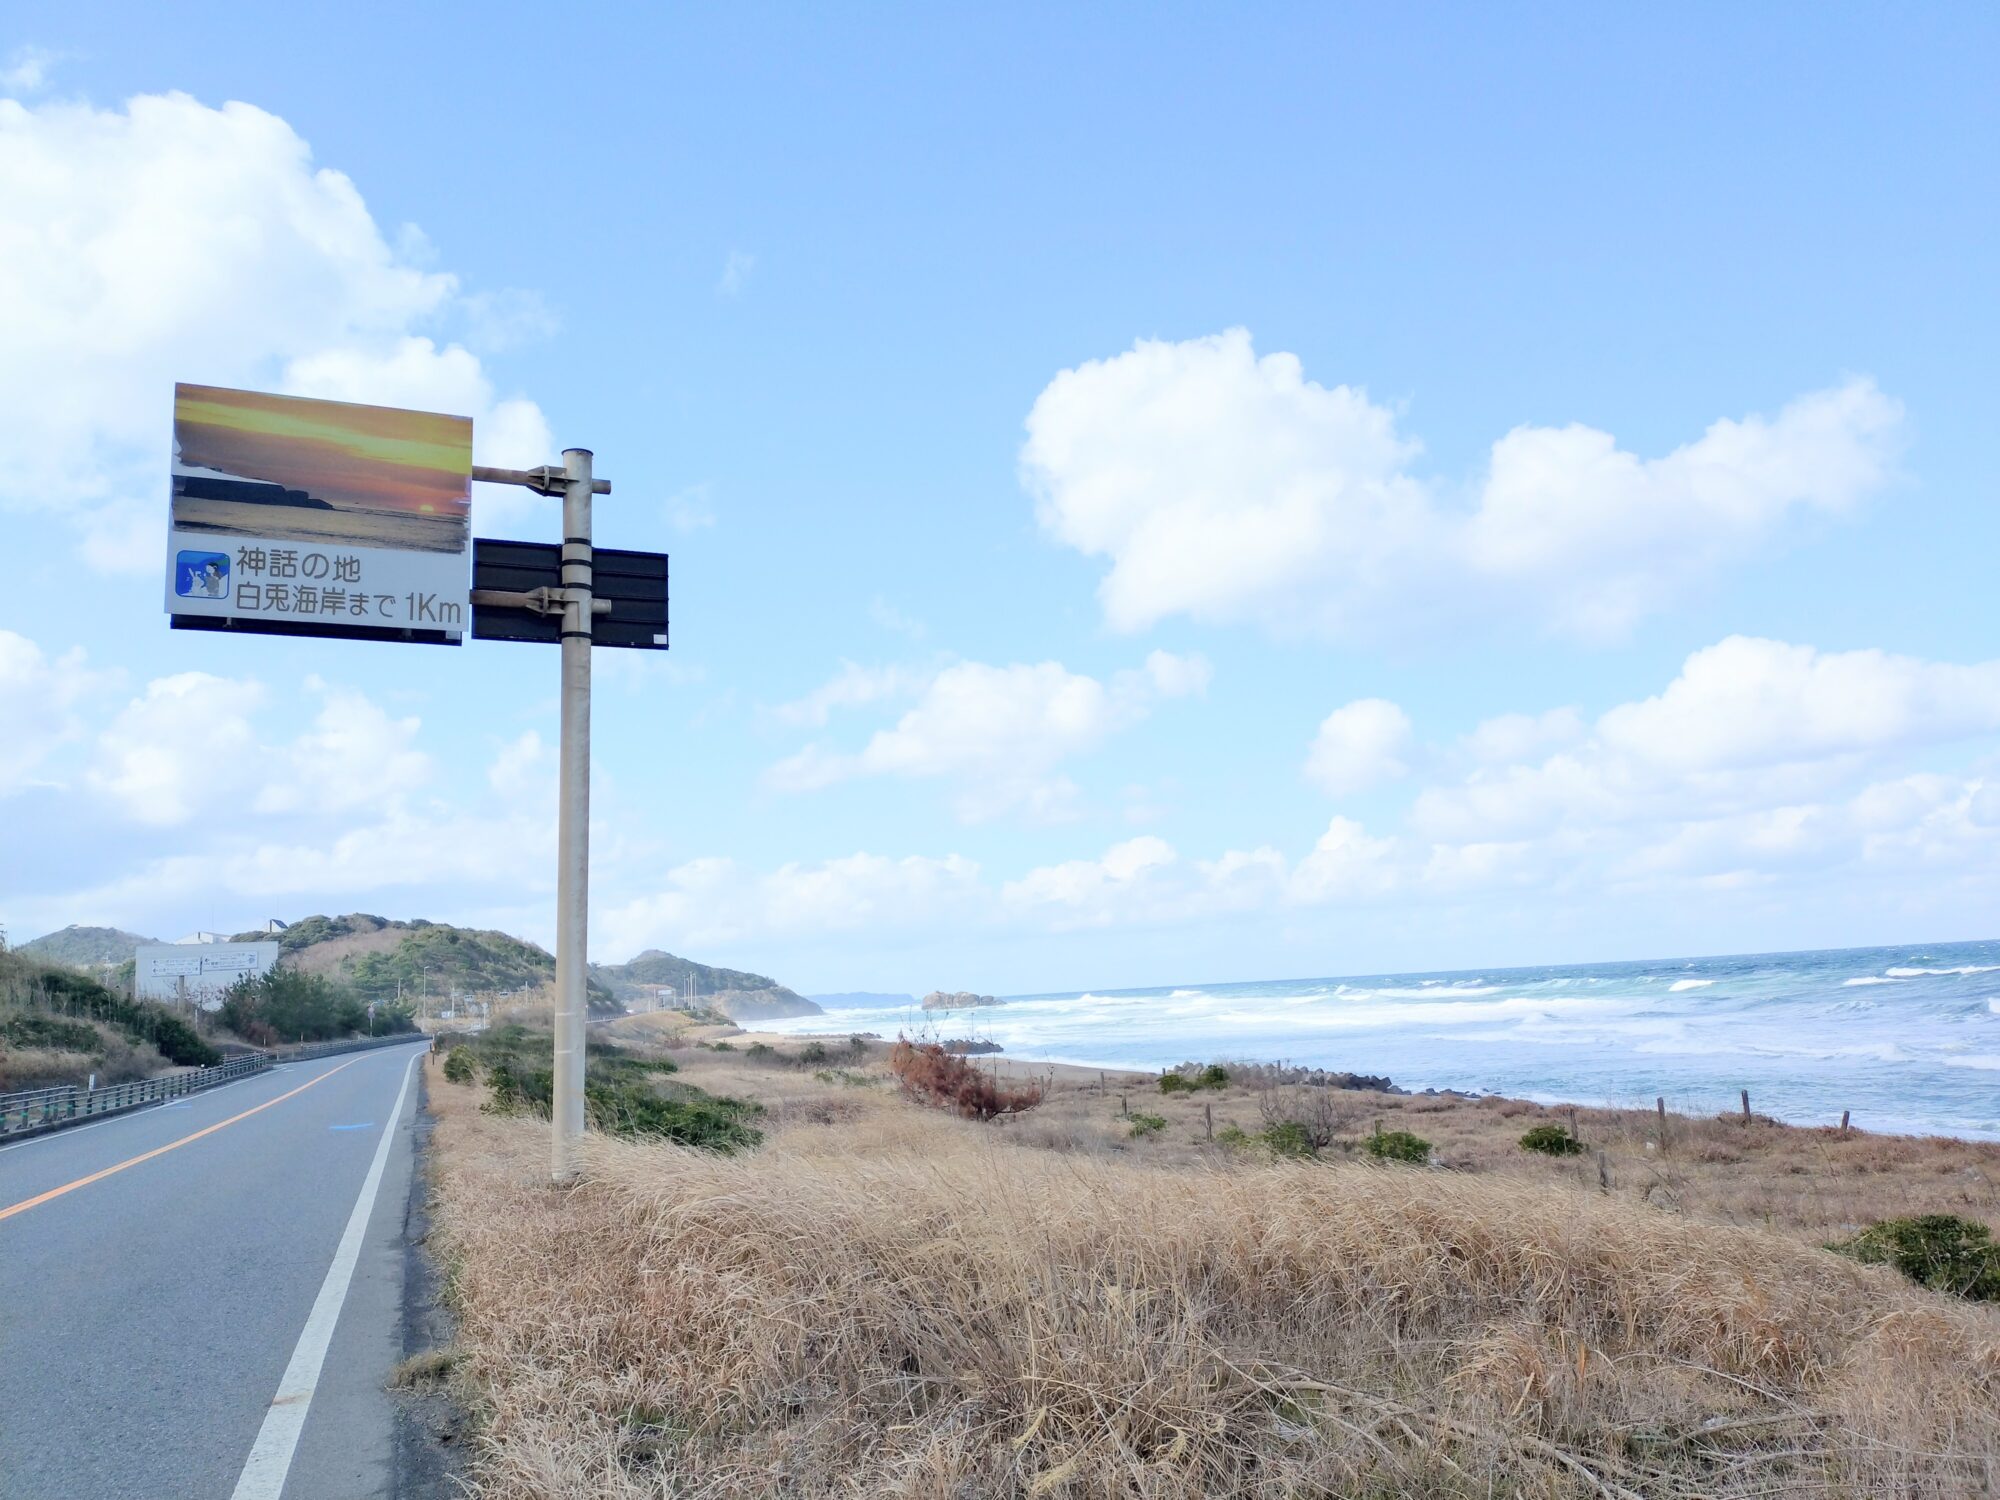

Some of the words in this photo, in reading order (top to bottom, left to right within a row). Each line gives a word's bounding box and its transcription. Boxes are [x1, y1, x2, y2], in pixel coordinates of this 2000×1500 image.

[236, 545, 361, 583] 神話の地
[405, 592, 461, 624] 1Km
